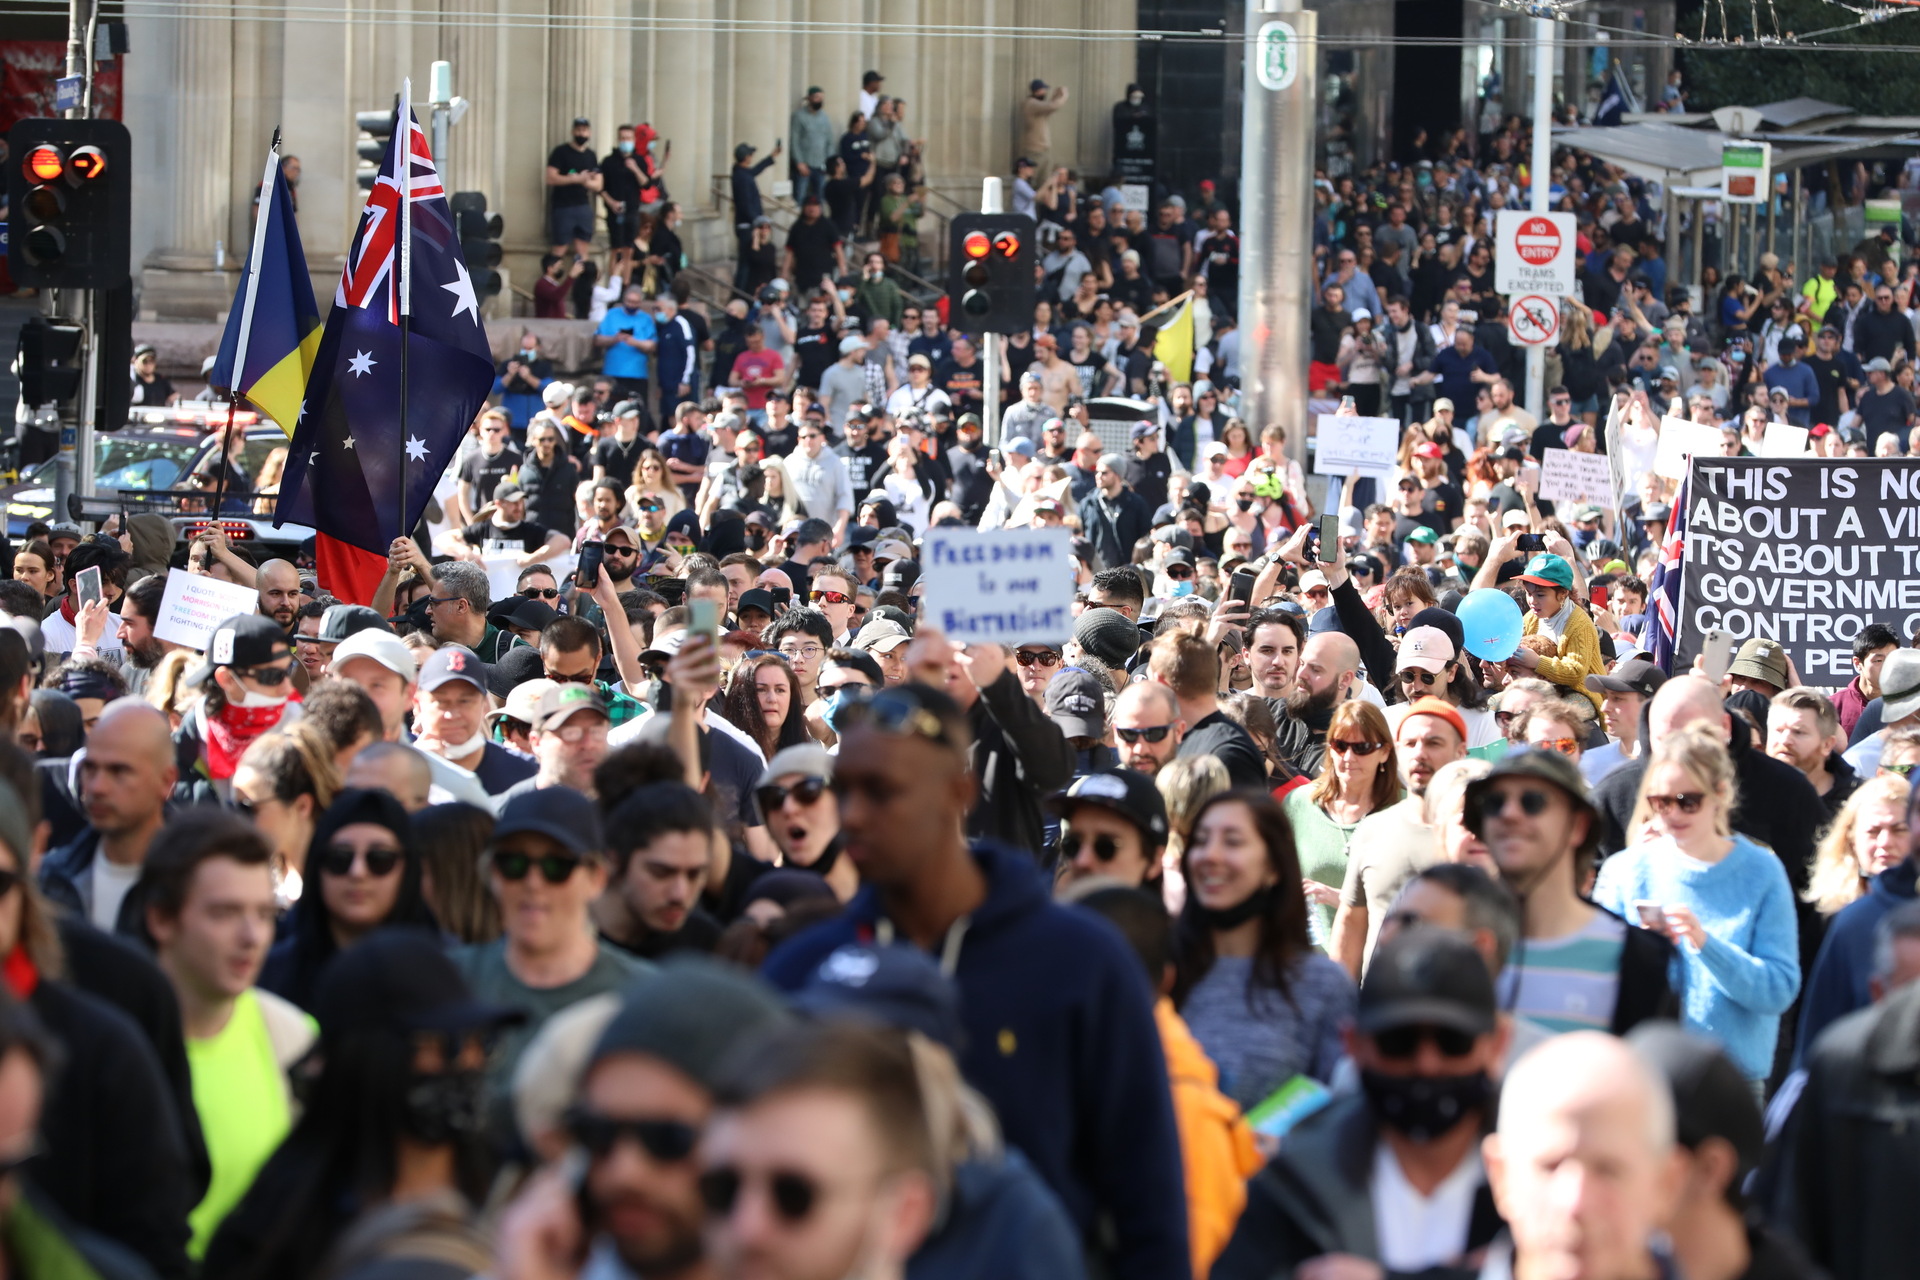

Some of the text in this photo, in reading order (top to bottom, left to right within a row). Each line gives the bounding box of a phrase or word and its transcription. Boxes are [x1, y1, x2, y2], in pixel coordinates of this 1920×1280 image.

[1530, 222, 1547, 234] NO
[1521, 246, 1555, 259] ENTRY
[1518, 267, 1555, 279] TRAMS
[1508, 280, 1564, 292] EXCEPTED
[1545, 479, 1560, 488] YOU
[1699, 466, 1792, 501] THIS
[1820, 467, 1859, 500] IS
[1690, 497, 1920, 541] ABOUT A VI
[1685, 531, 1920, 577] IT'S ABOUT T
[181, 594, 221, 611] MORRISON
[872, 609, 886, 622] R
[169, 615, 216, 633] FIGHTING FO
[446, 650, 466, 671] B
